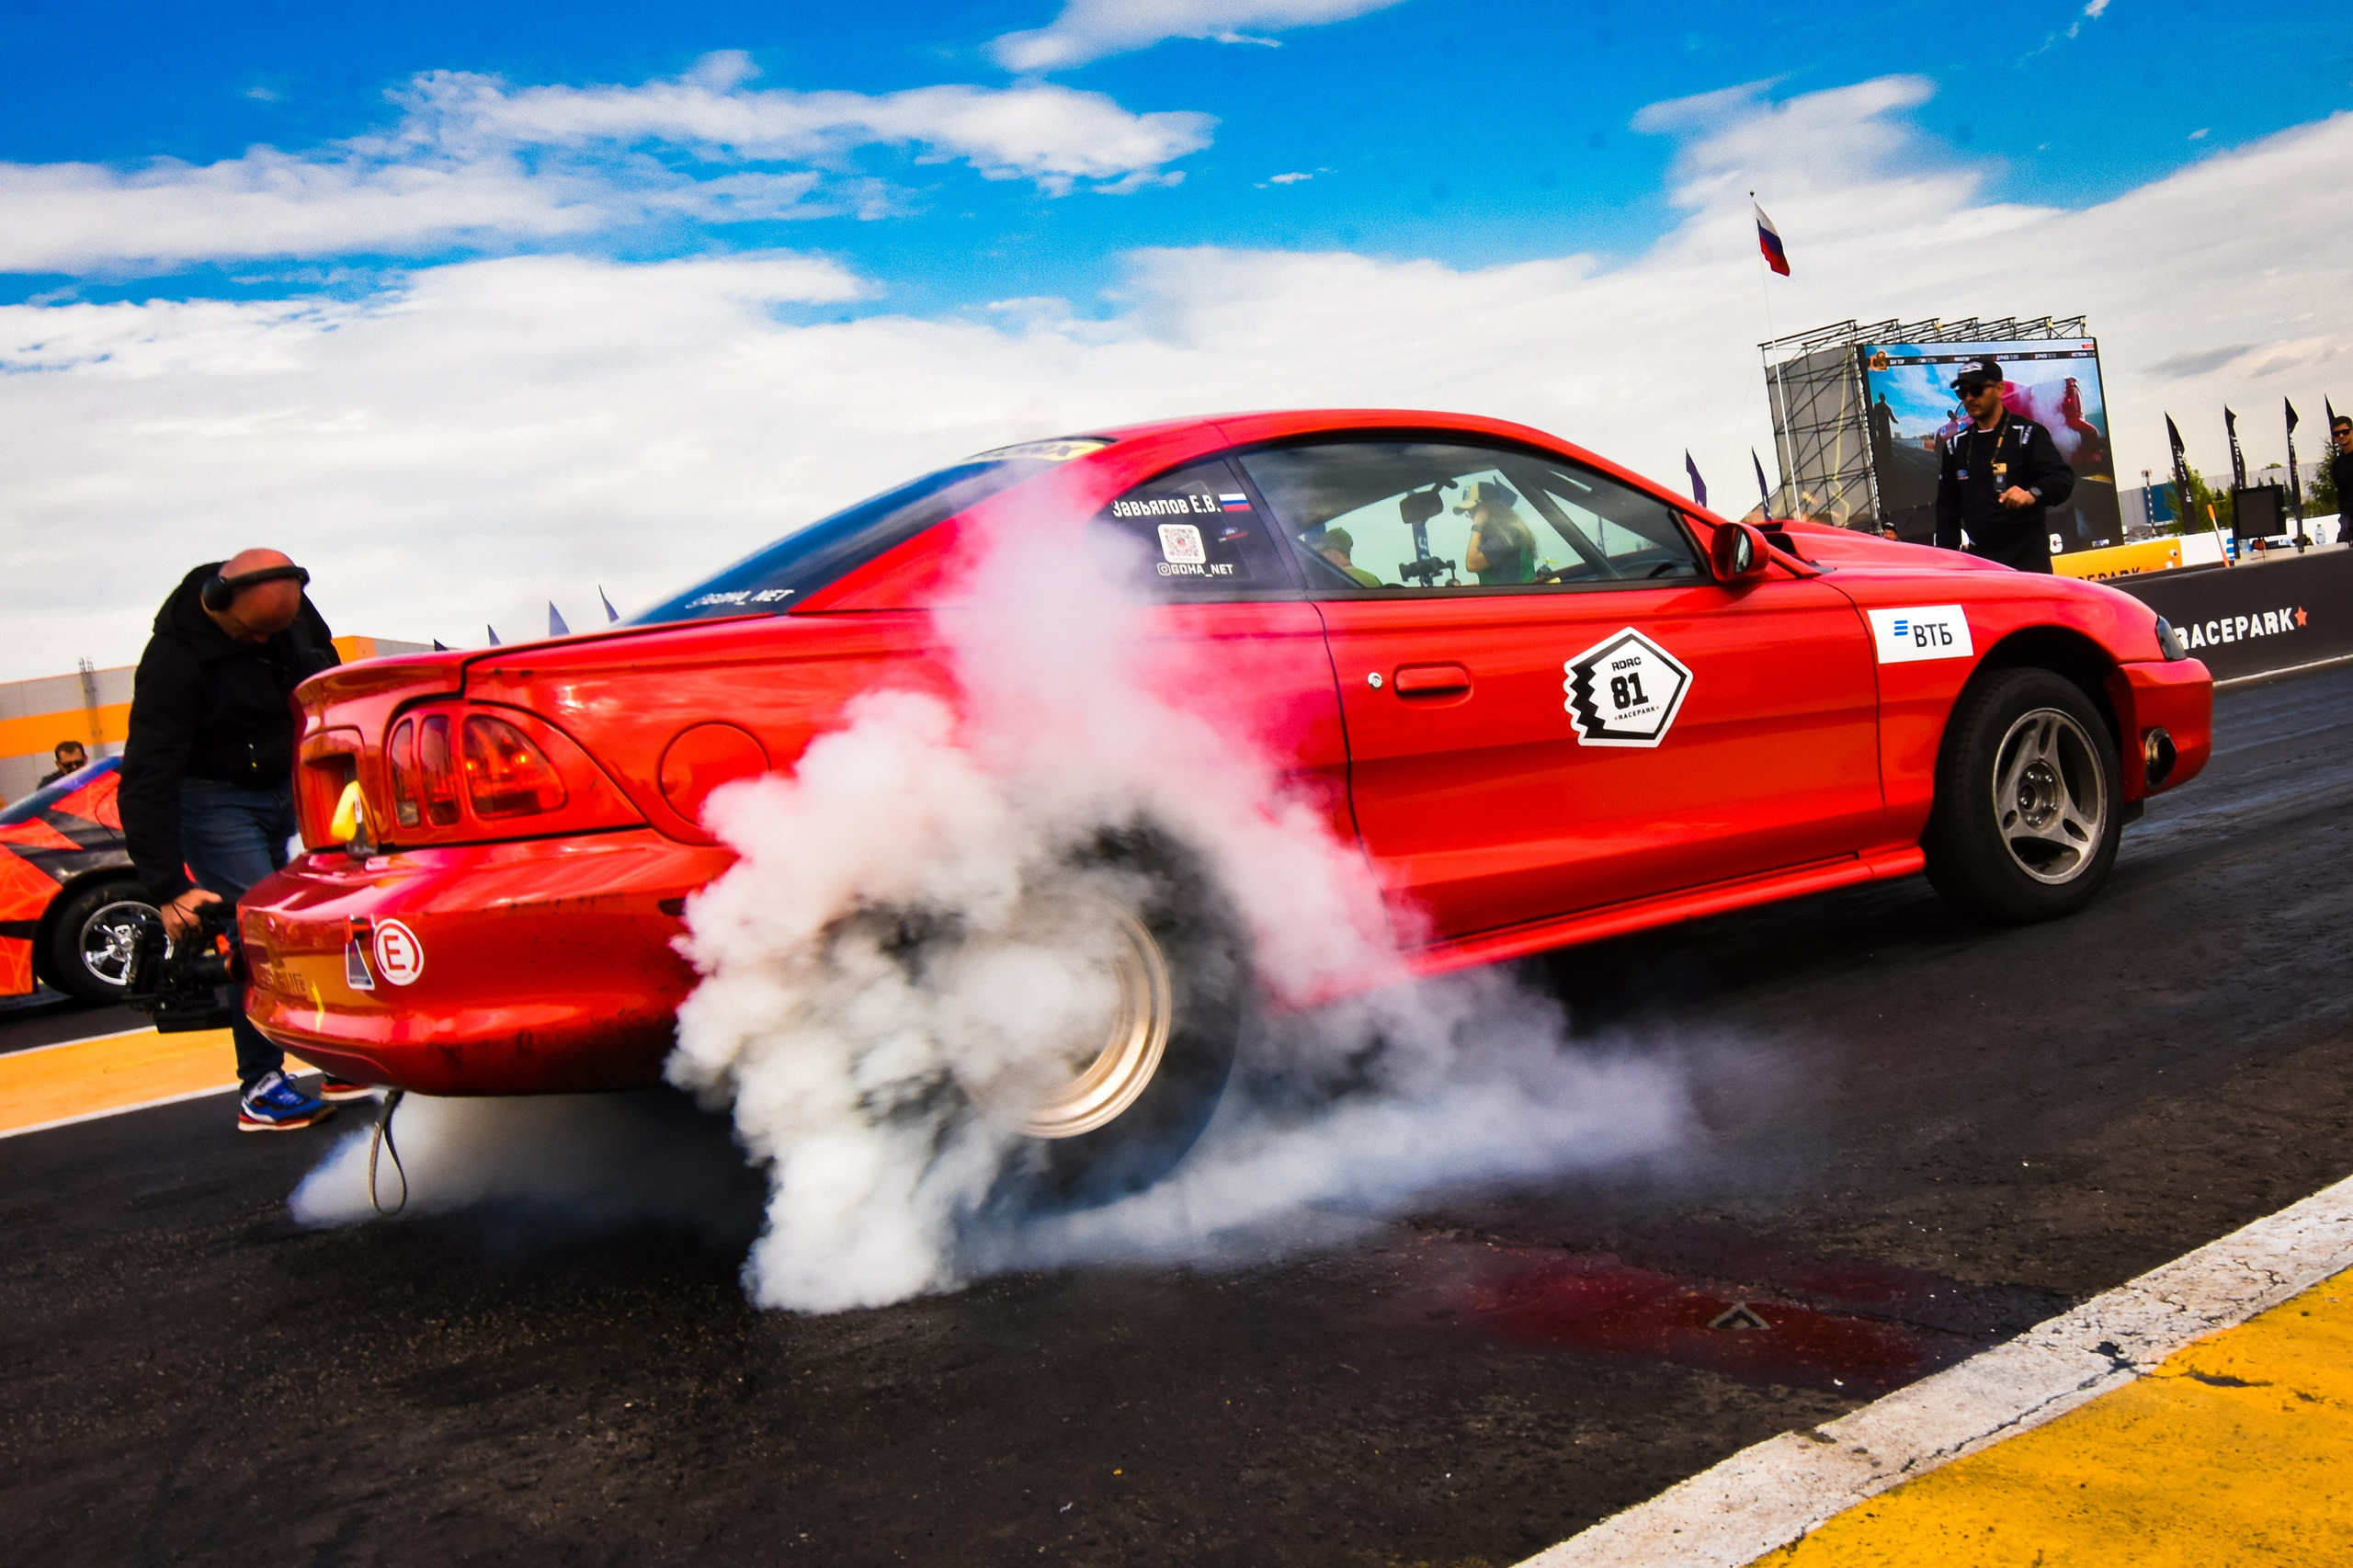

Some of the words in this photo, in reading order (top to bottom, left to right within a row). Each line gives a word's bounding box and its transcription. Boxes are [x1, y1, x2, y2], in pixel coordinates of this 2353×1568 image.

[1913, 623, 1953, 648] ВТБ
[2173, 608, 2295, 650] RACEPARK
[1611, 656, 1642, 671] RDRC
[1610, 672, 1649, 710] 81
[1618, 706, 1656, 721] RACEPARK
[383, 935, 406, 971] E
